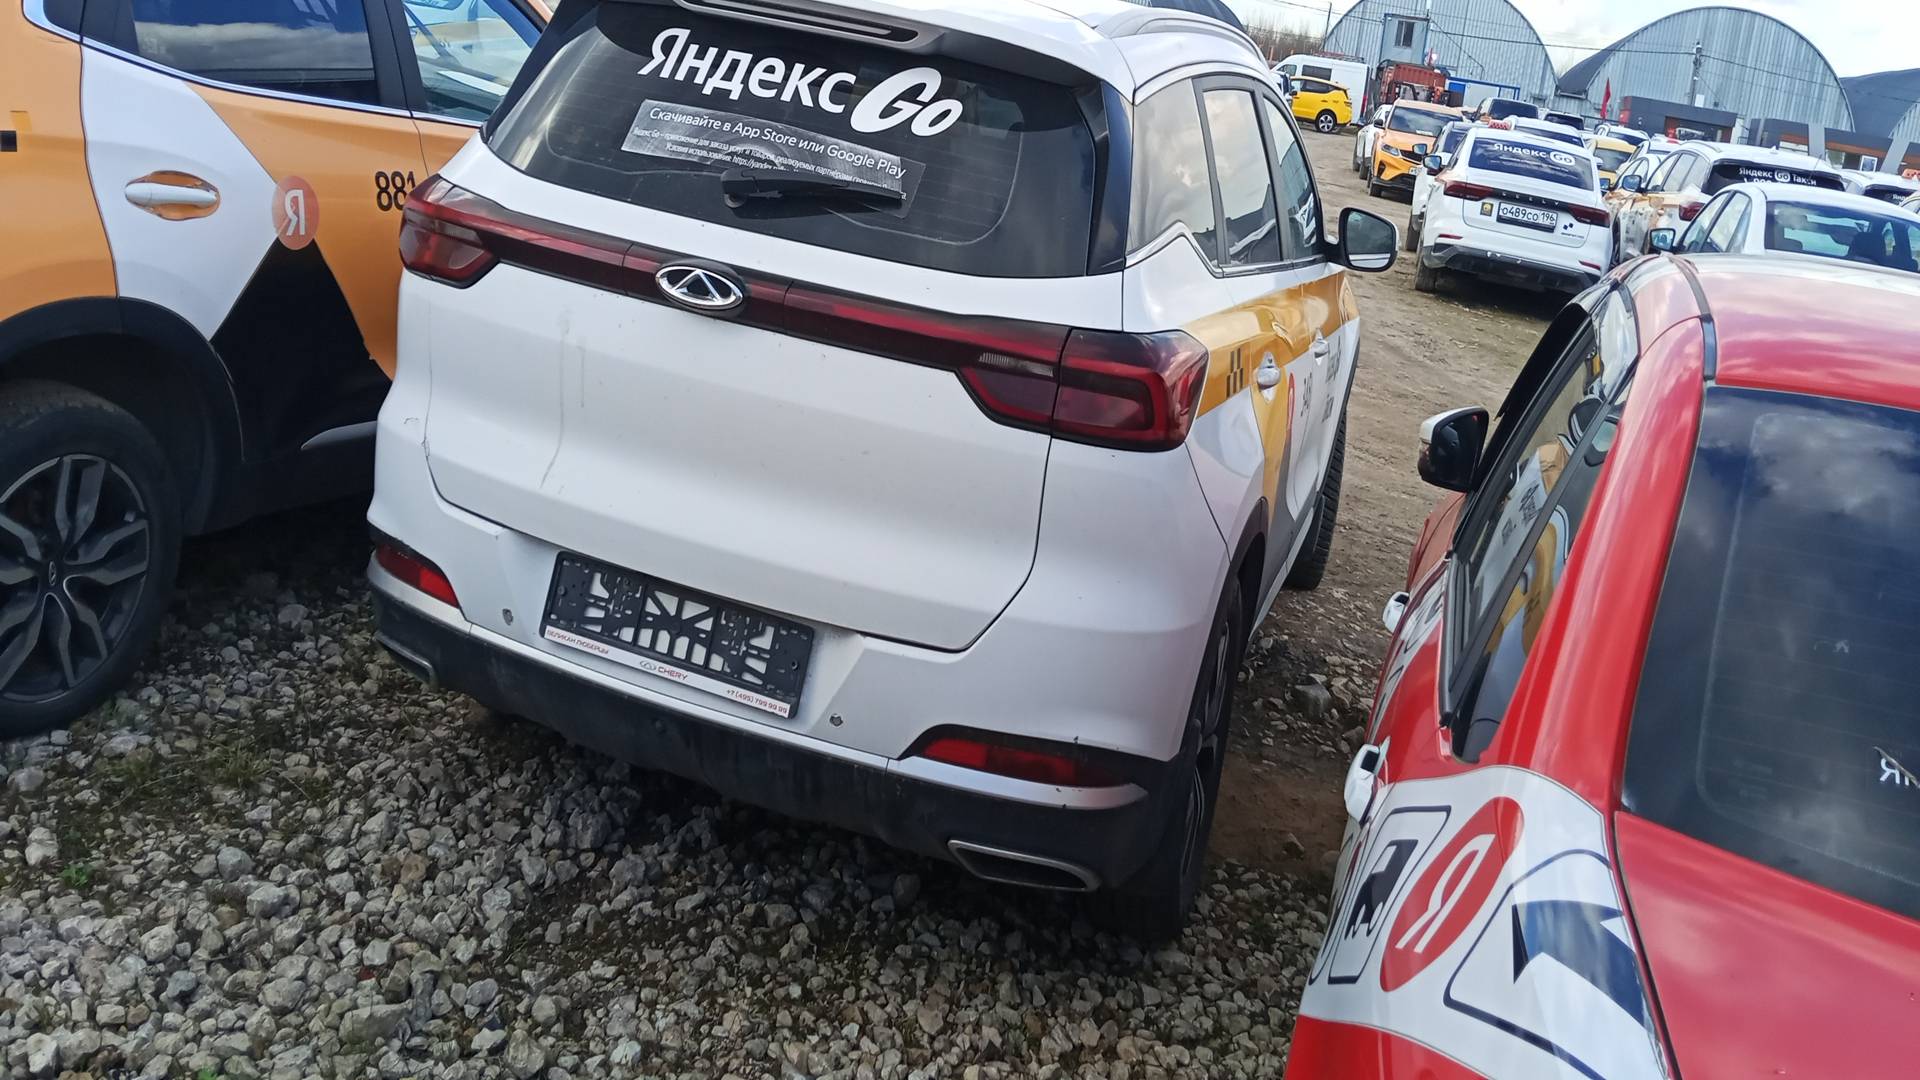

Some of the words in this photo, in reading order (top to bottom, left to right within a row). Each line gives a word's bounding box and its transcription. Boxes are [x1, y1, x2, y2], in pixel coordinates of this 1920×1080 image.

[637, 27, 857, 114] Яндекс
[850, 66, 963, 137] Go
[649, 107, 721, 130] Скачивайте
[722, 122, 731, 132] в
[732, 122, 761, 138] App
[761, 128, 797, 147] Store
[798, 139, 825, 154] или
[827, 144, 875, 168] Google
[877, 159, 907, 179] Play
[1493, 143, 1547, 158] Яндекс
[1739, 167, 1773, 178] Яндекс
[284, 189, 305, 236] Я
[657, 666, 688, 681] CHERY
[735, 690, 754, 704] (495)
[1395, 834, 1495, 954] Я
